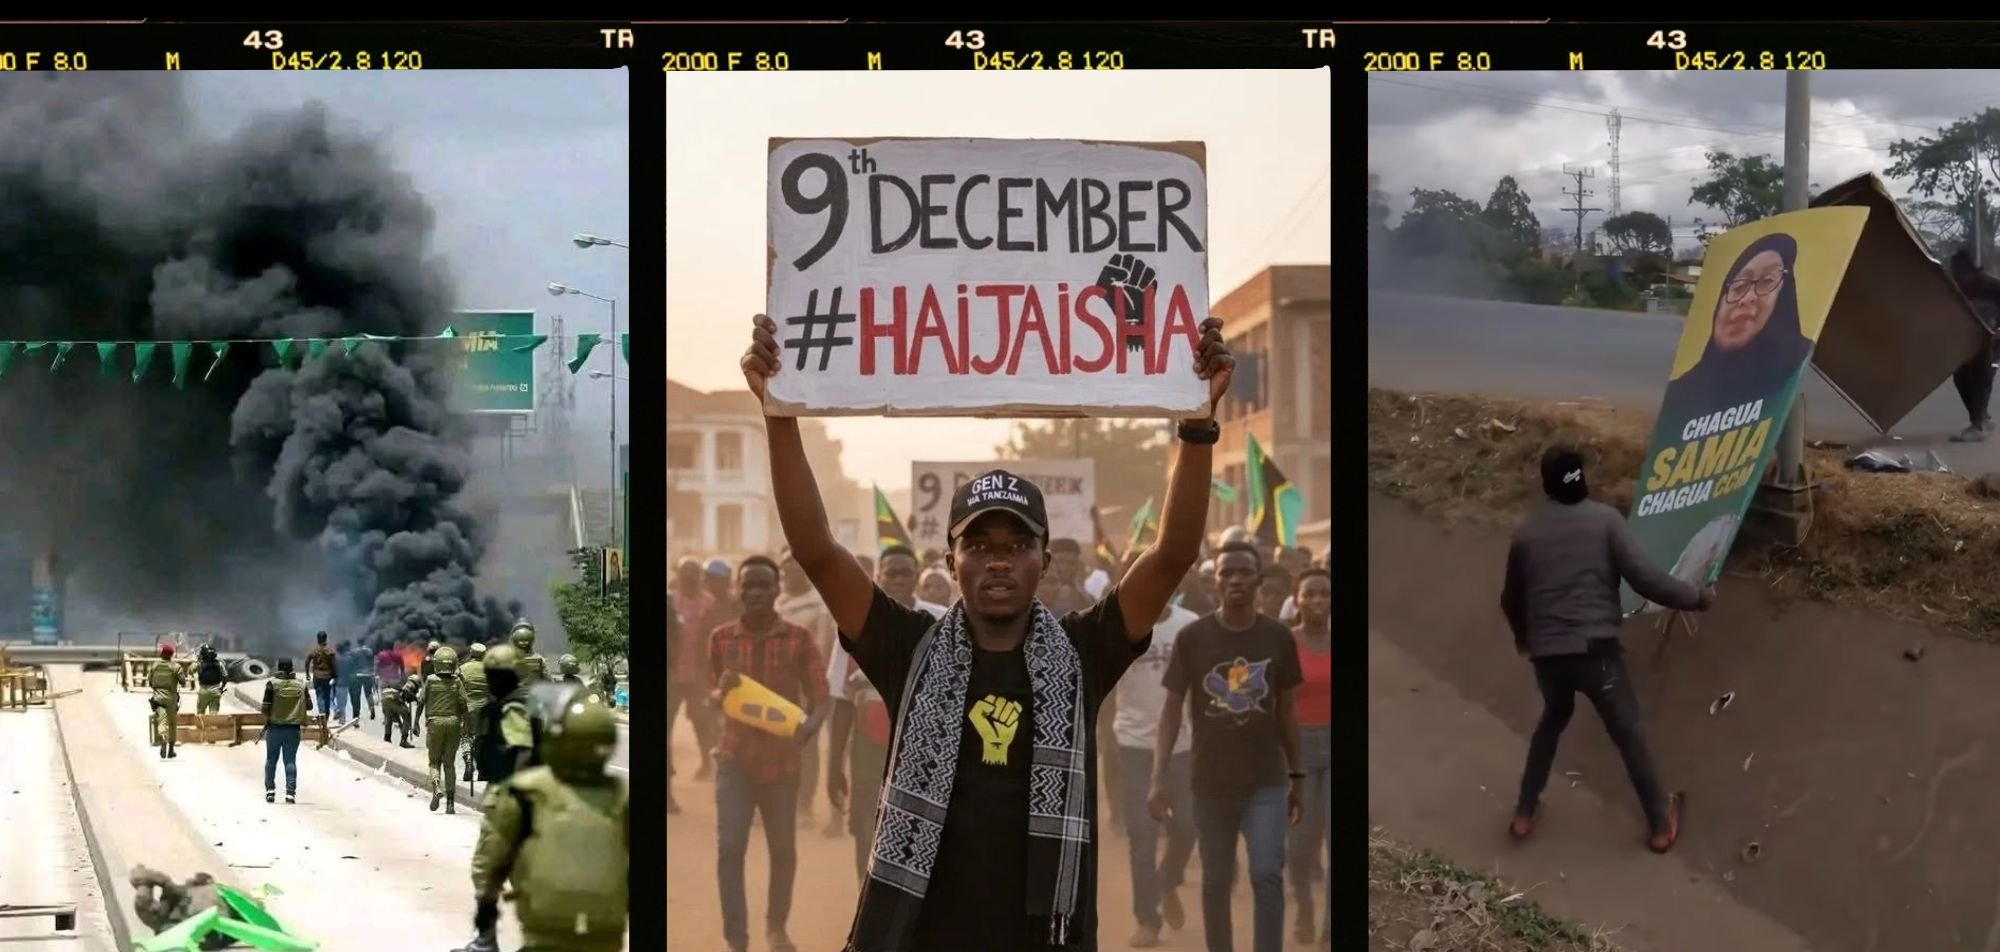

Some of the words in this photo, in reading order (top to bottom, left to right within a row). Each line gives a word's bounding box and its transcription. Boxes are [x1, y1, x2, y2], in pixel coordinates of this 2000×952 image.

[869, 173, 1206, 254] DECEMBER
[1682, 398, 1764, 441] CHAGUA
[1646, 417, 1772, 492] SAMIA
[918, 471, 943, 513] 9
[971, 474, 1004, 495] GEN
[1007, 476, 1019, 492] Z
[1637, 479, 1714, 517] CHAGUA
